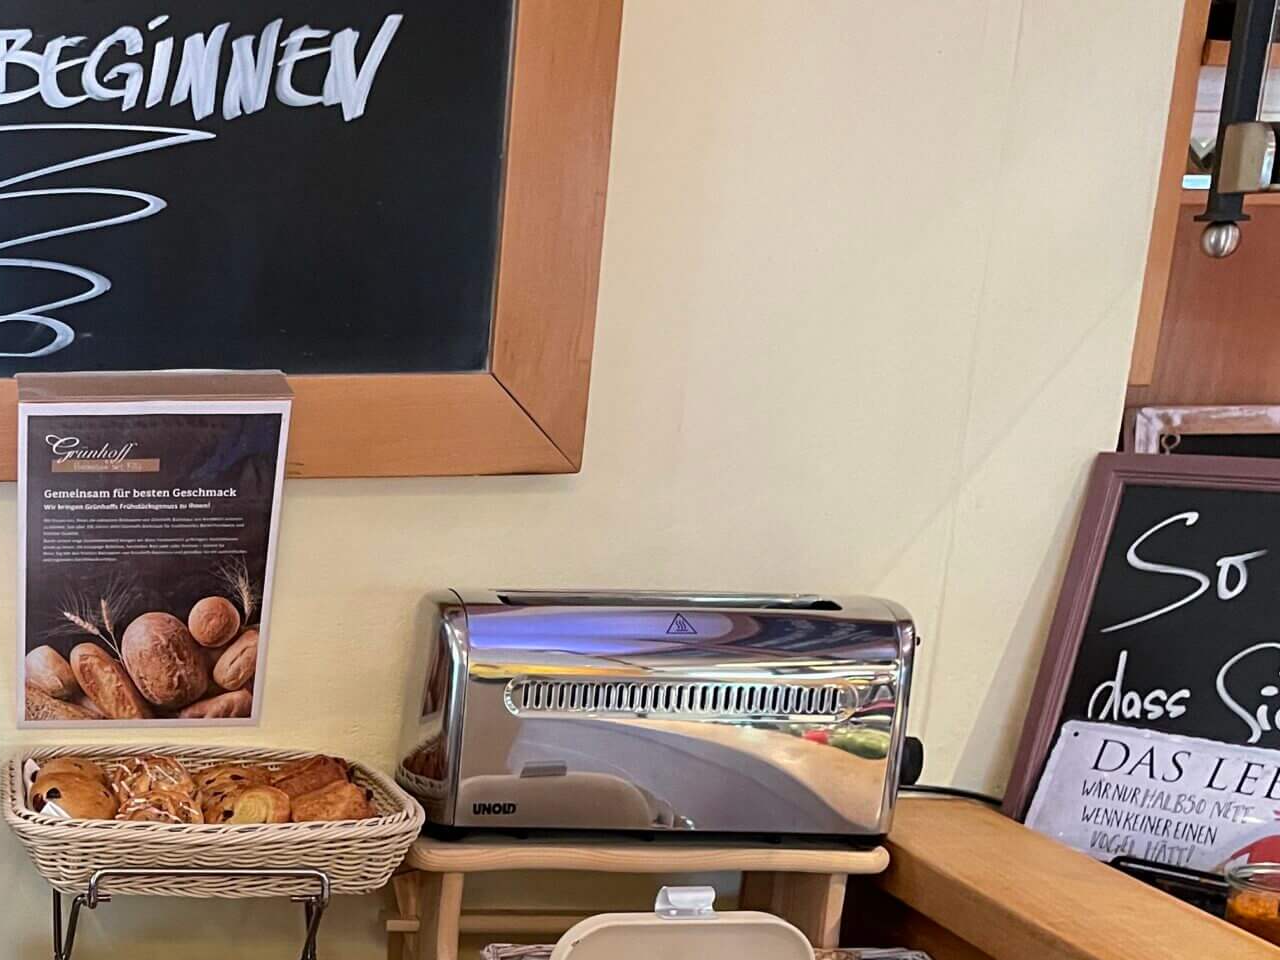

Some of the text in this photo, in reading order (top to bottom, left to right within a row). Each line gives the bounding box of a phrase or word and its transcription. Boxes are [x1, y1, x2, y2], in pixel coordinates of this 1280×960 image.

[43, 487, 237, 499] Gemeinsam für besten Geschmack
[1100, 511, 1268, 633] So
[1087, 642, 1280, 744] dass Si
[1091, 738, 1192, 783] DAS
[473, 803, 516, 815] UNOLD
[1111, 783, 1141, 804] NUR
[1081, 805, 1219, 847] WENN KEINER EINEN
[1090, 830, 1137, 857] VOGEL
